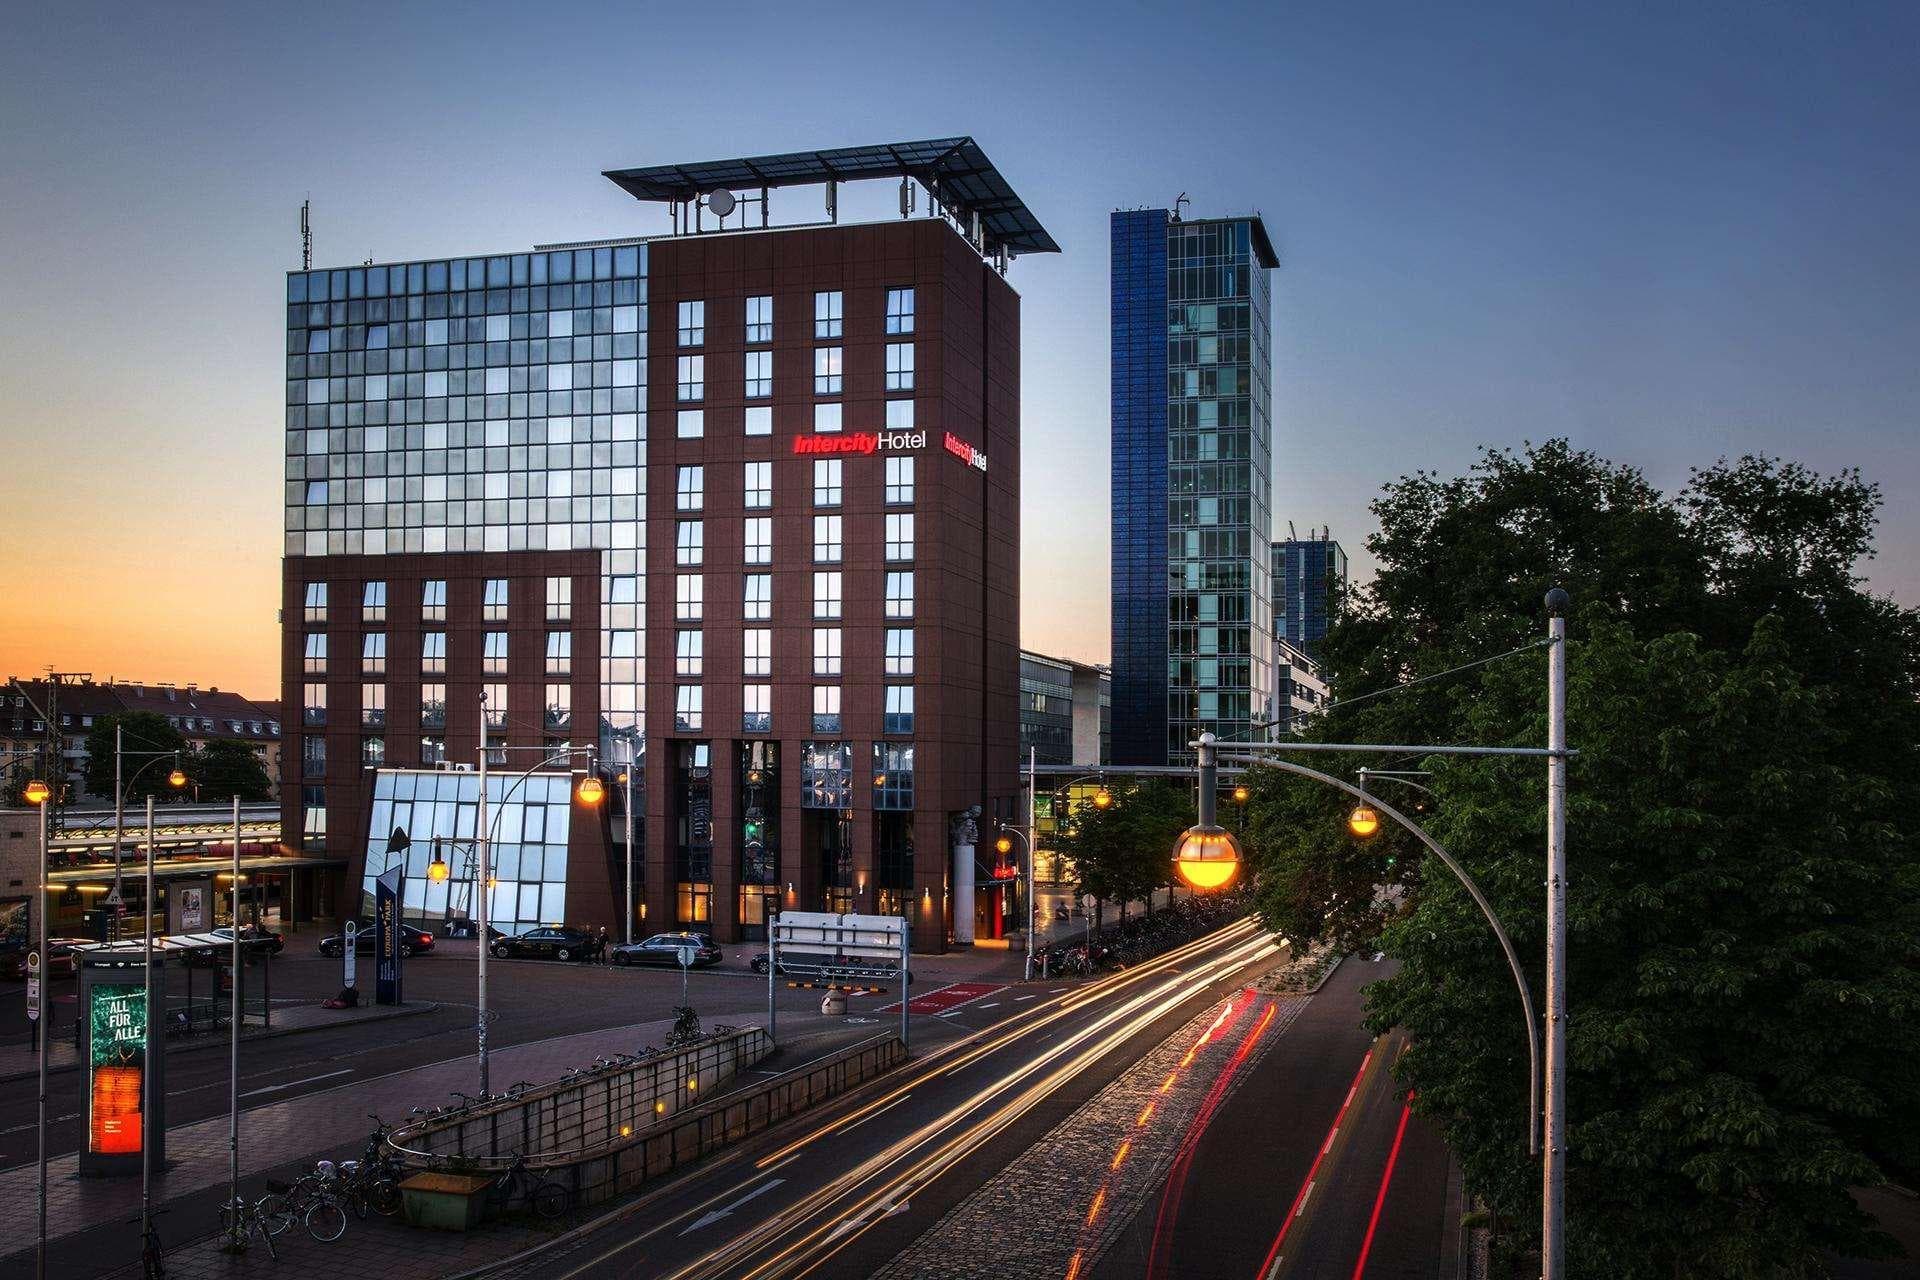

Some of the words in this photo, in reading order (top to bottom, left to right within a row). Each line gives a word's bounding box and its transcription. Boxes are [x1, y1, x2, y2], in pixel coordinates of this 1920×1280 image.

[110, 1000, 129, 1013] ALL
[109, 1013, 131, 1027] FÜR
[115, 1026, 141, 1041] ALLE
